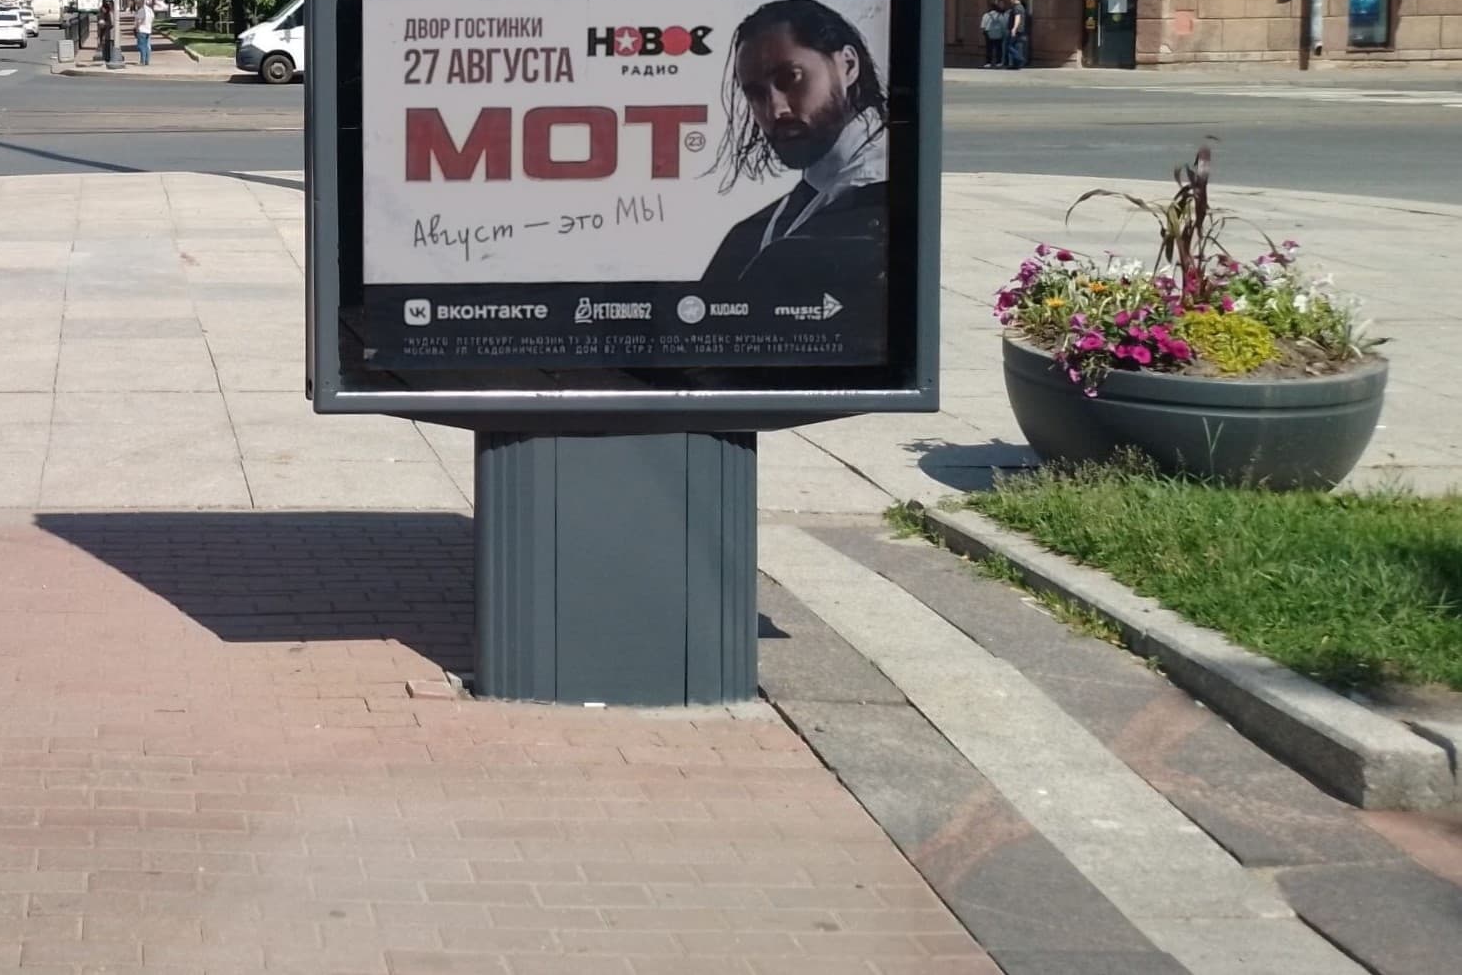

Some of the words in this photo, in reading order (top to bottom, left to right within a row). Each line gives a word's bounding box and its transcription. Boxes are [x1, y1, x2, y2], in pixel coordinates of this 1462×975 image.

[404, 18, 450, 41] ДВОР
[455, 17, 543, 39] ГОСТИНКИ
[404, 48, 440, 85] 27
[446, 46, 575, 84] АВГУСТА
[621, 65, 679, 76] РАДИО
[405, 104, 709, 182] МОТ
[413, 213, 514, 262] Август
[558, 214, 604, 234] это
[616, 194, 665, 225] МЫ
[709, 303, 749, 316] KUDAGO
[774, 306, 822, 316] music
